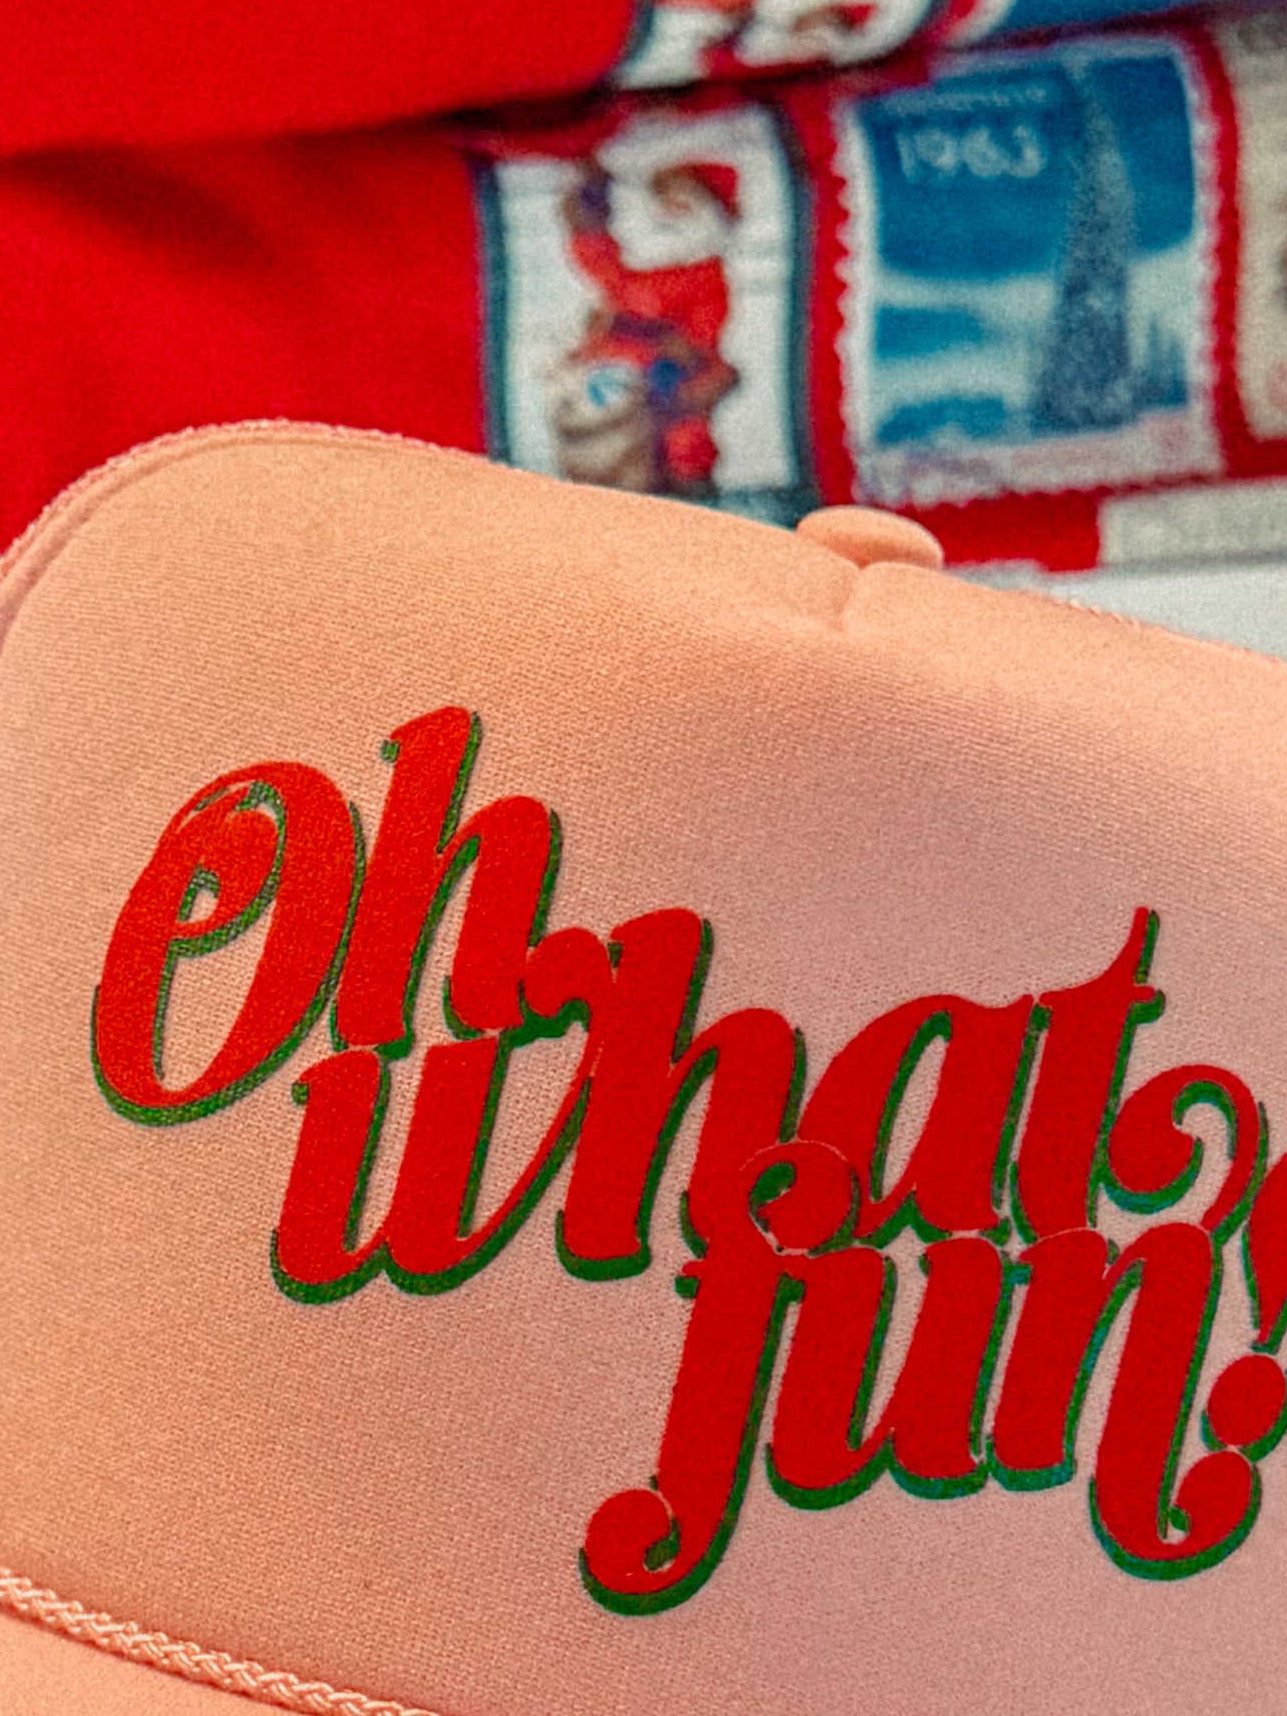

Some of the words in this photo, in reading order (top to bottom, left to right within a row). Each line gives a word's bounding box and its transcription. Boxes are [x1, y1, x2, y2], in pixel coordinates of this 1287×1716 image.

[893, 125, 1048, 181] 1963
[92, 704, 563, 1127] Oh
[270, 905, 1269, 1305] what
